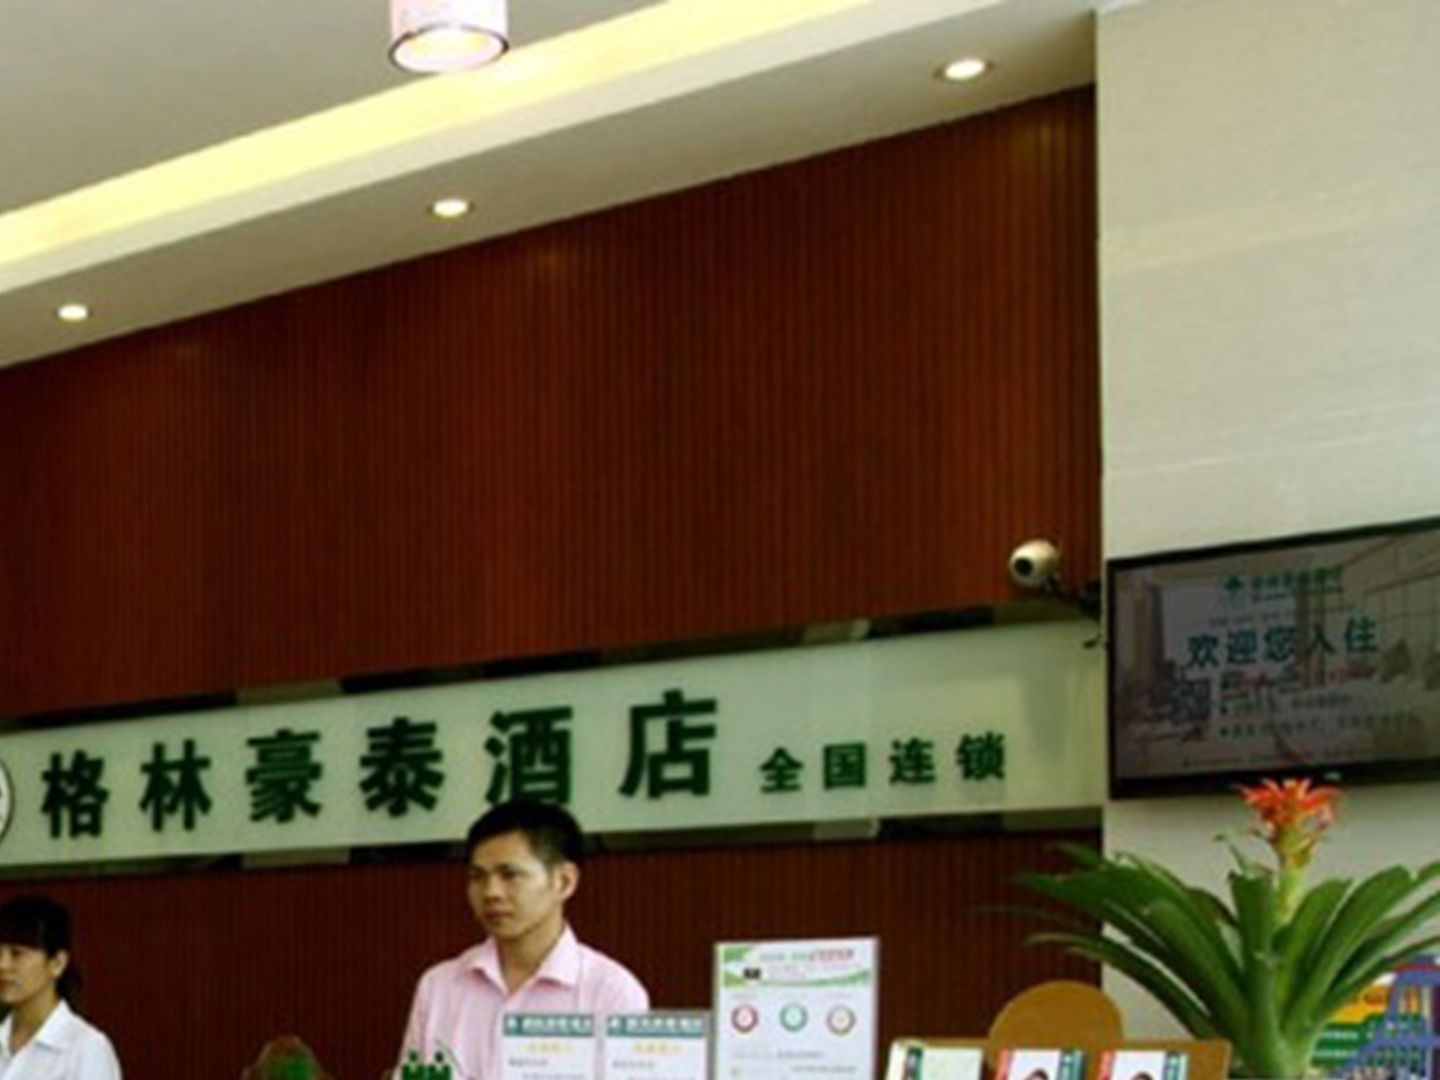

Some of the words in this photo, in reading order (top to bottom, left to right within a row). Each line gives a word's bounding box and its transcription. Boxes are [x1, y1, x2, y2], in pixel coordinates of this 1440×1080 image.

[1185, 616, 1377, 669] 欢迎您入住
[41, 689, 717, 839] 格林豪泰酒店
[760, 731, 1006, 793] 全国连锁
